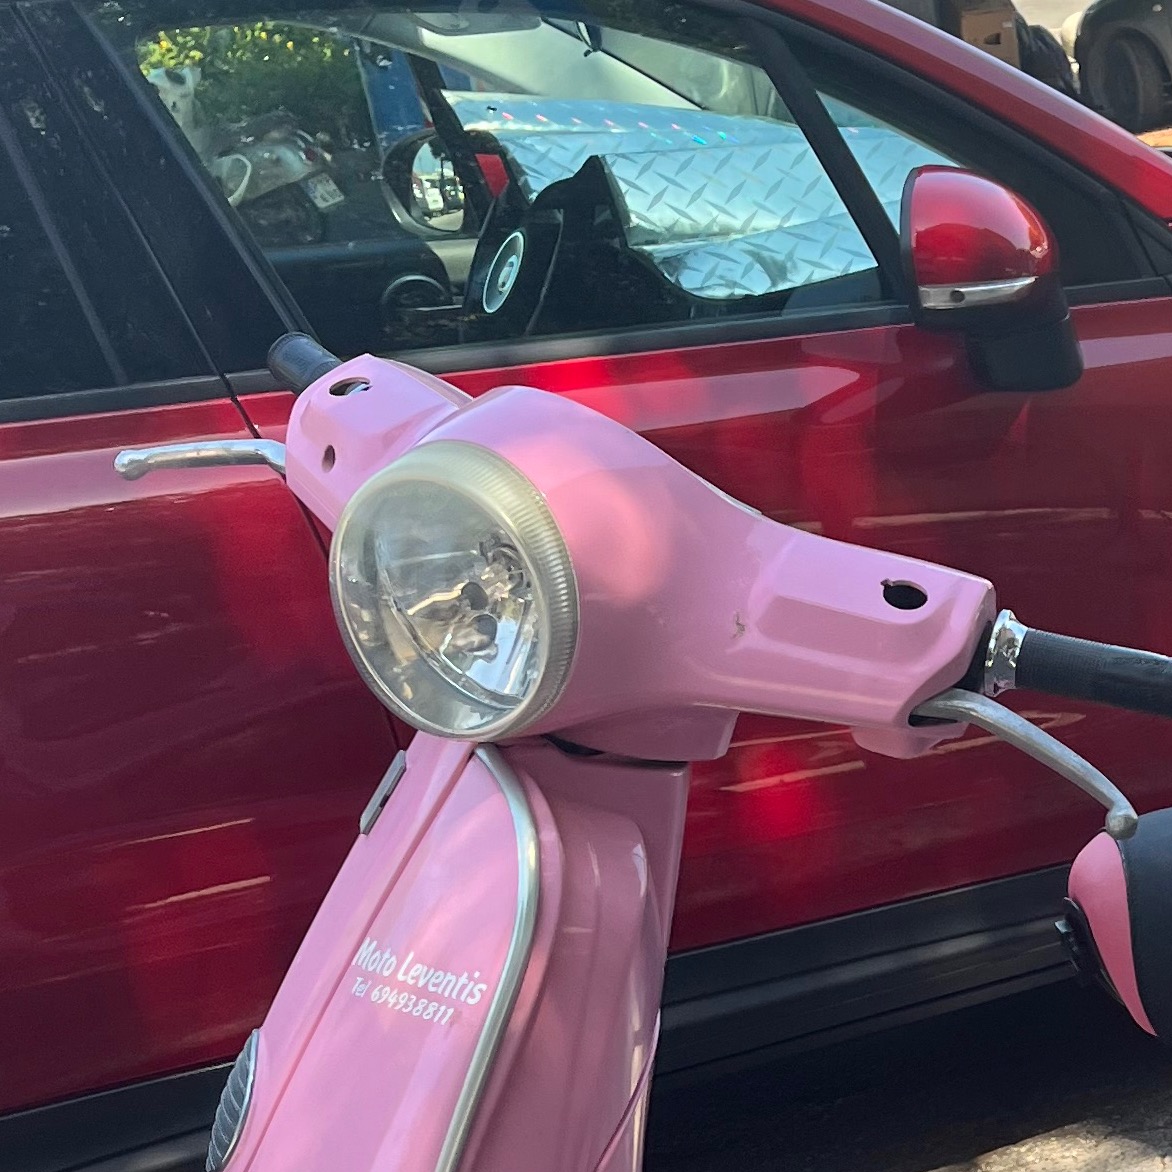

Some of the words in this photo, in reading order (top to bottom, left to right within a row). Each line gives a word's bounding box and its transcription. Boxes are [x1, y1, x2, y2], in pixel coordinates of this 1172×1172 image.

[351, 937, 397, 977] Moto
[397, 951, 487, 1005] Leventis
[352, 976, 372, 998] Tel
[371, 984, 454, 1025] 694938811
